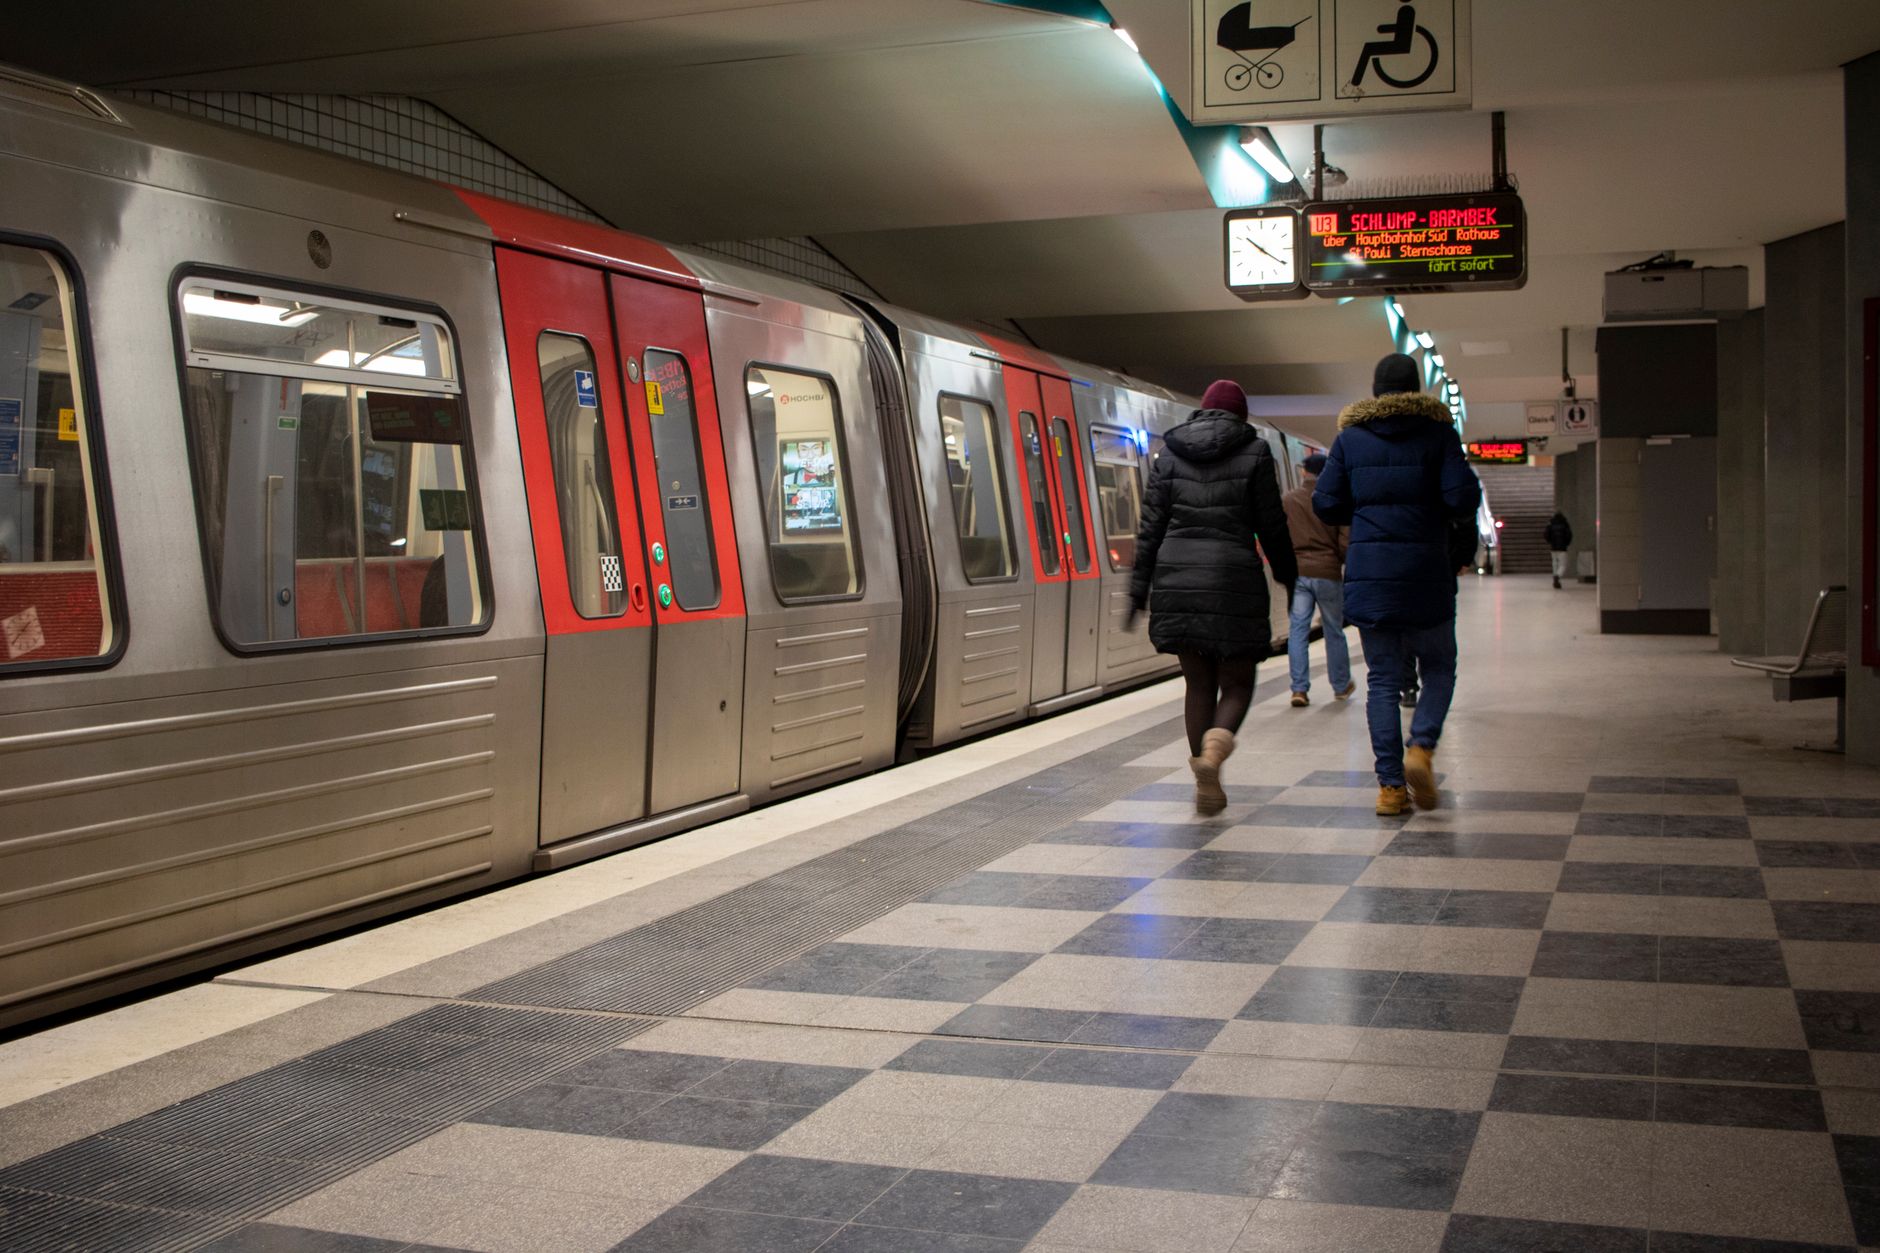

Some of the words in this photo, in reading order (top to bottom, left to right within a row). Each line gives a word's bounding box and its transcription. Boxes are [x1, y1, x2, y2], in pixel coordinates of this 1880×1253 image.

[1316, 216, 1332, 233] U3
[1351, 211, 1416, 231] SCHLUMP
[1429, 208, 1497, 227] BARMBEK
[1323, 235, 1347, 247] über
[1355, 230, 1426, 247] Hauptbahnhof
[1427, 229, 1448, 242] Süd
[1456, 228, 1500, 241] Rathaus
[1400, 244, 1472, 257] Sternschanze
[1428, 259, 1456, 272] fährt
[1459, 257, 1494, 271] sofort
